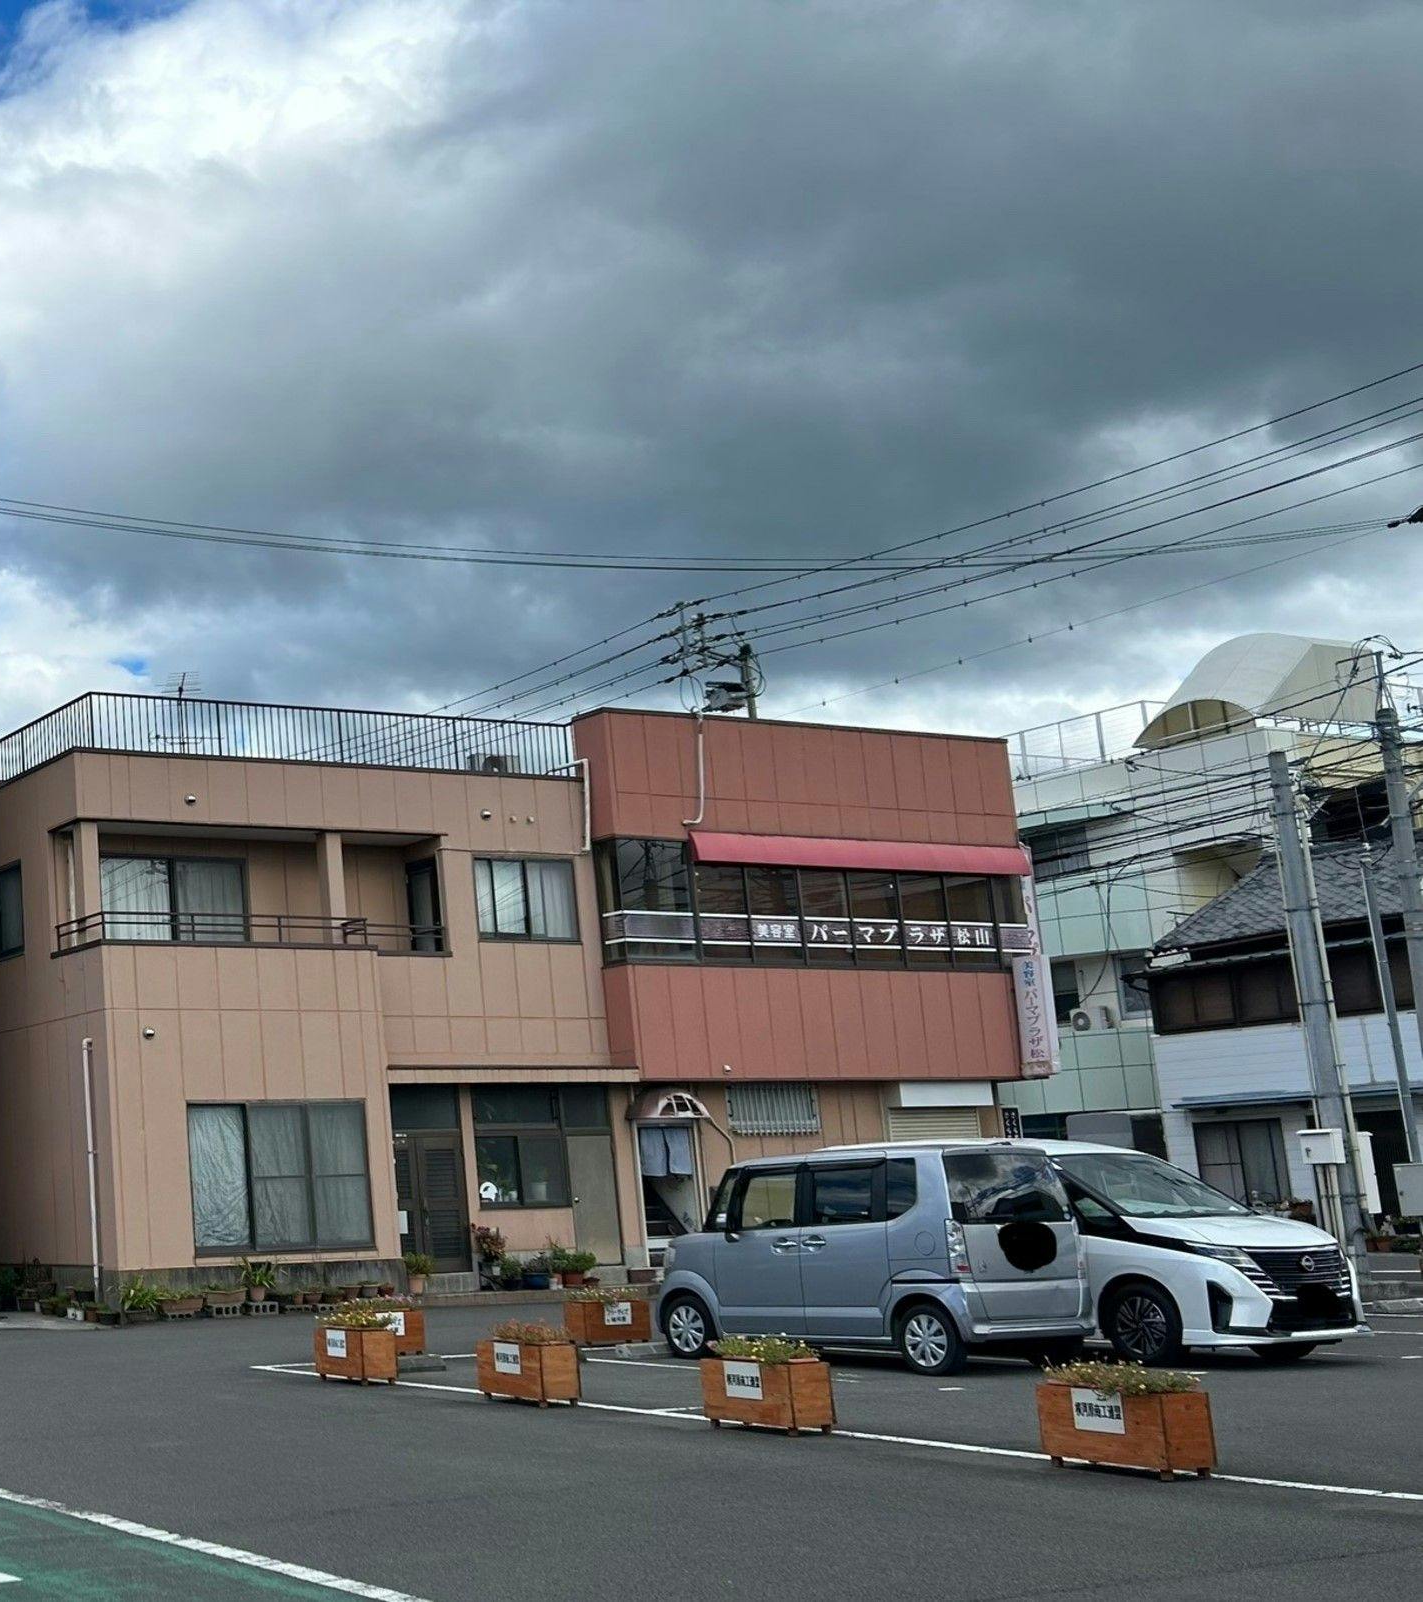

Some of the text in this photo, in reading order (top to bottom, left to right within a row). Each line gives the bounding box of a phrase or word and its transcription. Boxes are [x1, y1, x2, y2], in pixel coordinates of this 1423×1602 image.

[756, 923, 990, 946] 美容室 パーマプラザ松山
